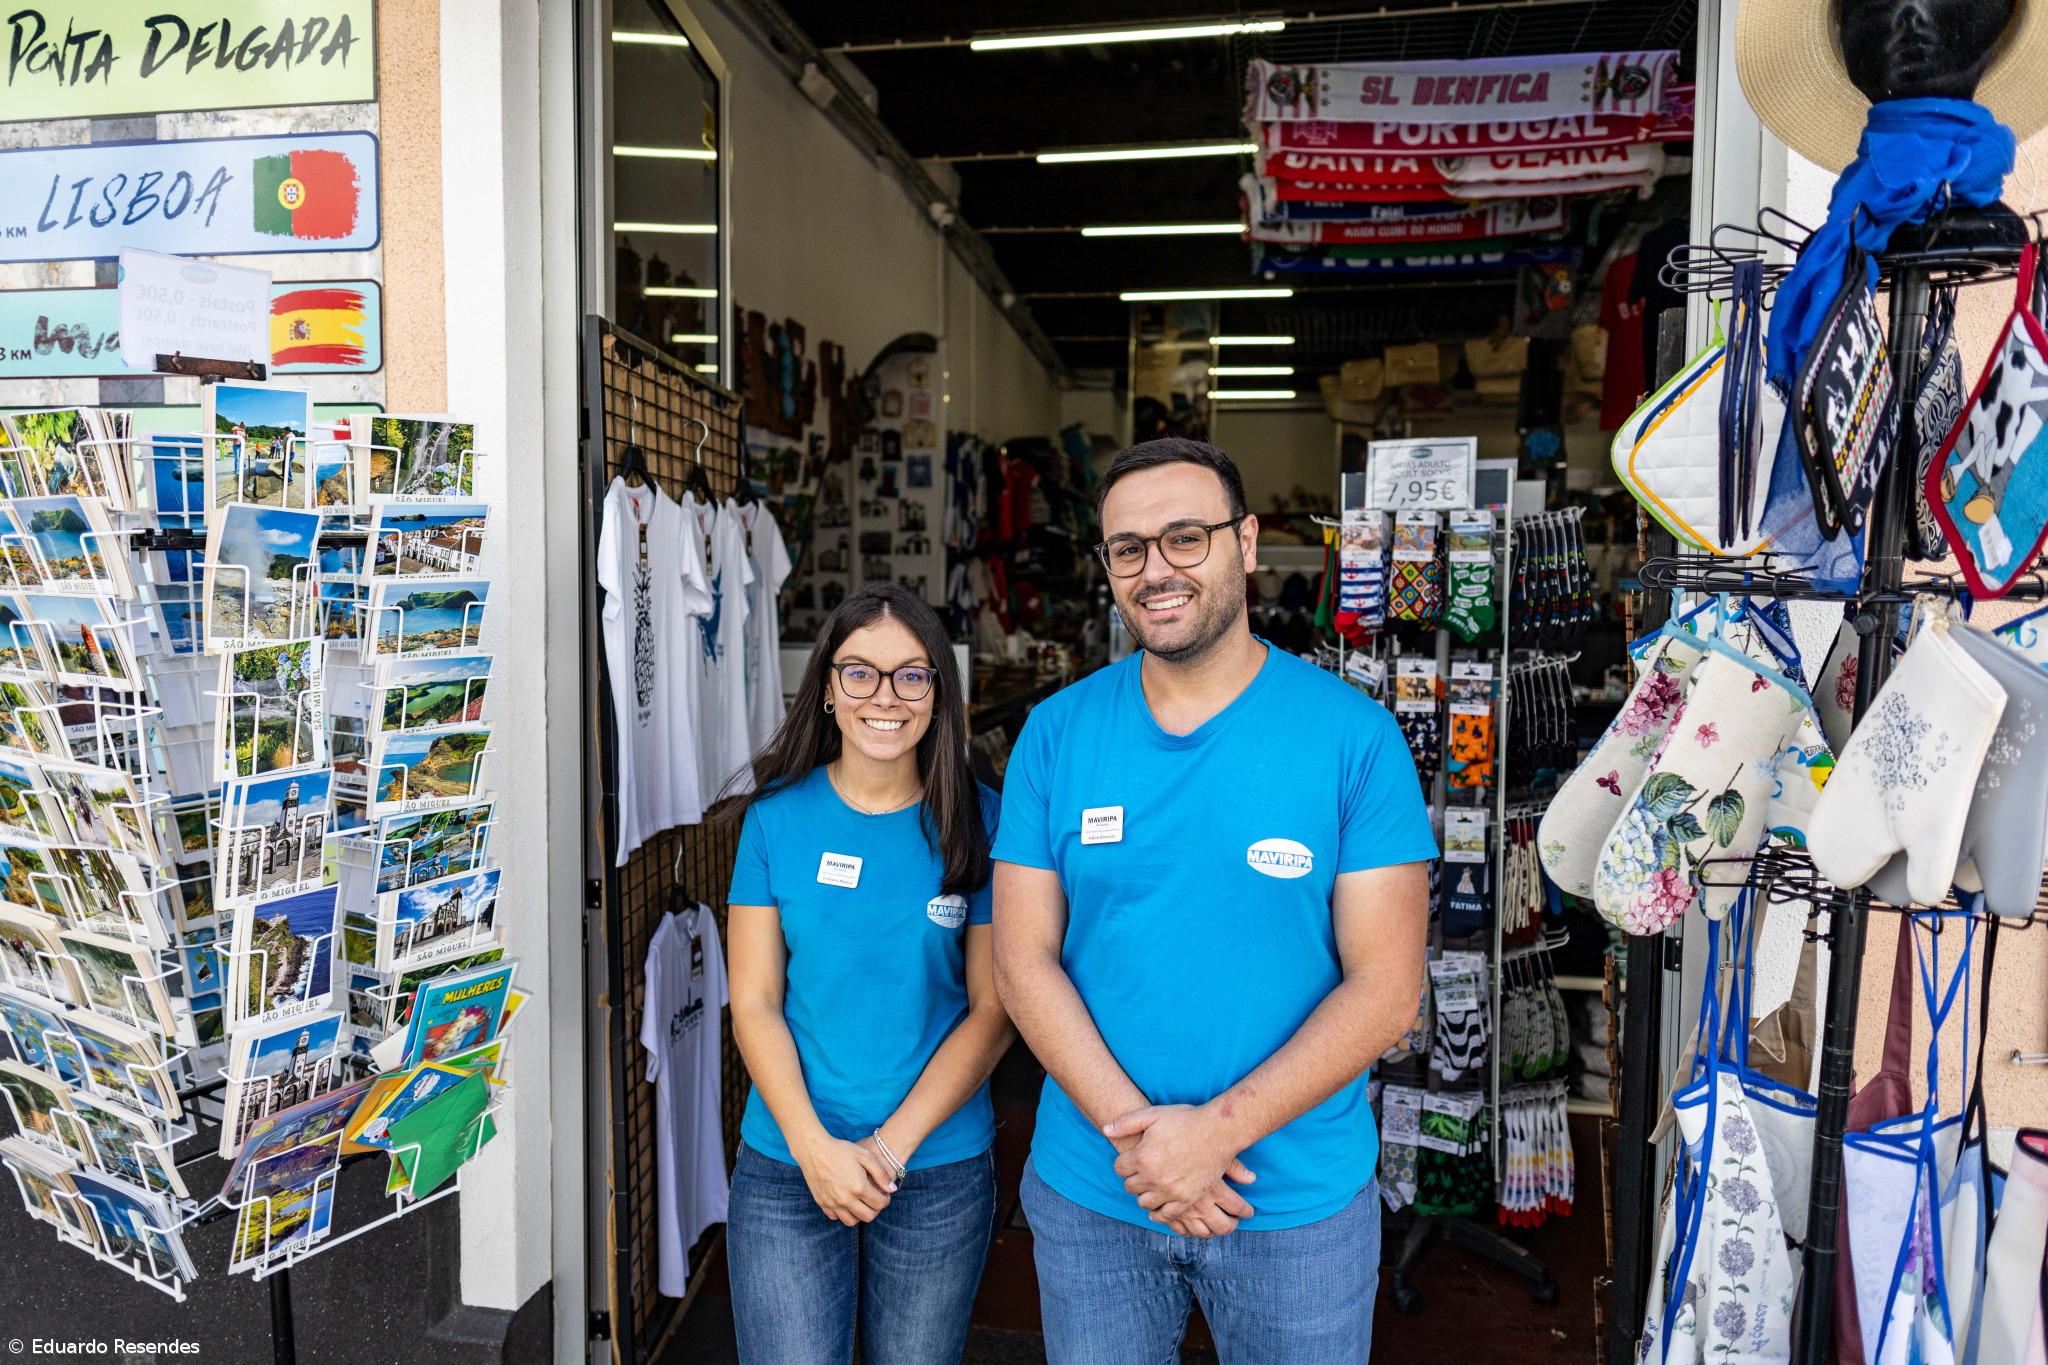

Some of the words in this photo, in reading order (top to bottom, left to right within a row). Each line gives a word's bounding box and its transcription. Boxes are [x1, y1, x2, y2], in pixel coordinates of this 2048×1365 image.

[7, 8, 120, 88] PONTA
[140, 14, 360, 80] DELGADA
[1360, 76, 1397, 106] SL
[1412, 71, 1551, 106] BENFICA
[1373, 114, 1609, 146] PORTUGAL
[37, 165, 234, 233] LISBOA
[6, 226, 27, 239] KM
[11, 349, 32, 361] KM
[1385, 479, 1457, 506] 7,95€
[1087, 815, 1118, 824] MAVIRIPA
[826, 860, 856, 871] MAVIRIPA
[1247, 849, 1312, 869] MAVIRIPA
[442, 976, 504, 1006] MULHERES
